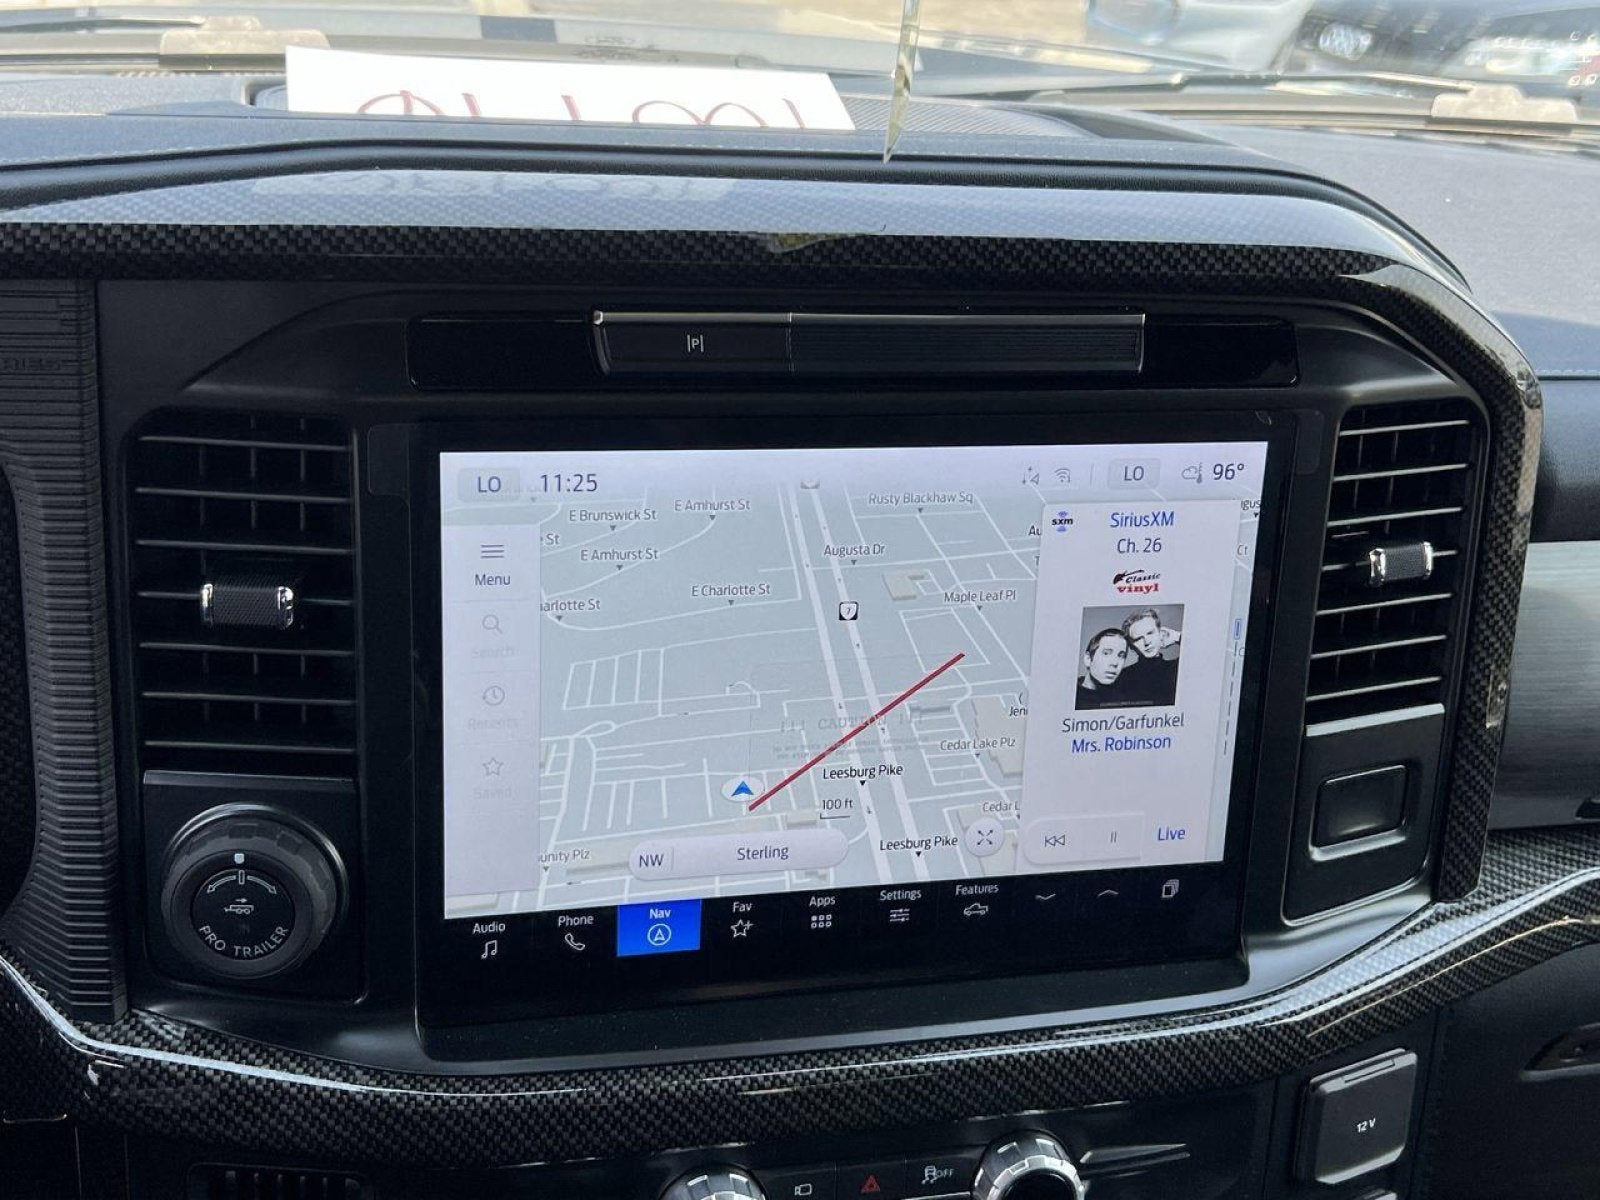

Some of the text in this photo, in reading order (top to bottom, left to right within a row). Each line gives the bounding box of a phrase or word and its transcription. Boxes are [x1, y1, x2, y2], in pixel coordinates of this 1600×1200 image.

[1124, 466, 1145, 481] LO
[477, 476, 501, 493] LO
[540, 473, 598, 492] 11:25
[675, 499, 750, 511] E Amhurst St
[868, 491, 973, 506] Rusty Blackhaw Sq
[569, 508, 657, 522] E Brunswick St
[1110, 510, 1175, 528] SiriusXM
[823, 544, 886, 557] Augusta Dr
[1116, 537, 1162, 554] Ch. 26
[580, 548, 659, 561] E Amhurst St
[474, 573, 511, 586] Menu
[691, 583, 771, 597] E Charlotte St
[1117, 583, 1159, 594] vinyl
[943, 591, 977, 604] Maple
[979, 590, 1003, 602] Leaf
[588, 599, 601, 611] St
[1061, 712, 1185, 734] Simon/Garfunkel
[940, 737, 1016, 751] Cedar Lake Plz
[1071, 735, 1172, 754] Mrs. Robinson
[823, 765, 904, 780] Leesburg Pike
[821, 798, 854, 810] 100 ft
[982, 800, 1013, 812] Cedar
[1157, 827, 1187, 841] Live
[879, 836, 959, 851] Leesburg Pike
[539, 849, 591, 863] unity Plz
[736, 845, 790, 861] Sterling
[639, 854, 664, 868] NW
[879, 888, 922, 901] Settings
[955, 882, 1000, 896] Features
[732, 902, 752, 913] Fav
[808, 895, 836, 907] Apps
[650, 907, 672, 919] Nav
[472, 921, 506, 934] Audio
[558, 914, 594, 927] Phone
[199, 924, 289, 958] PRO TRAILER
[1357, 1117, 1376, 1133] 12 V
